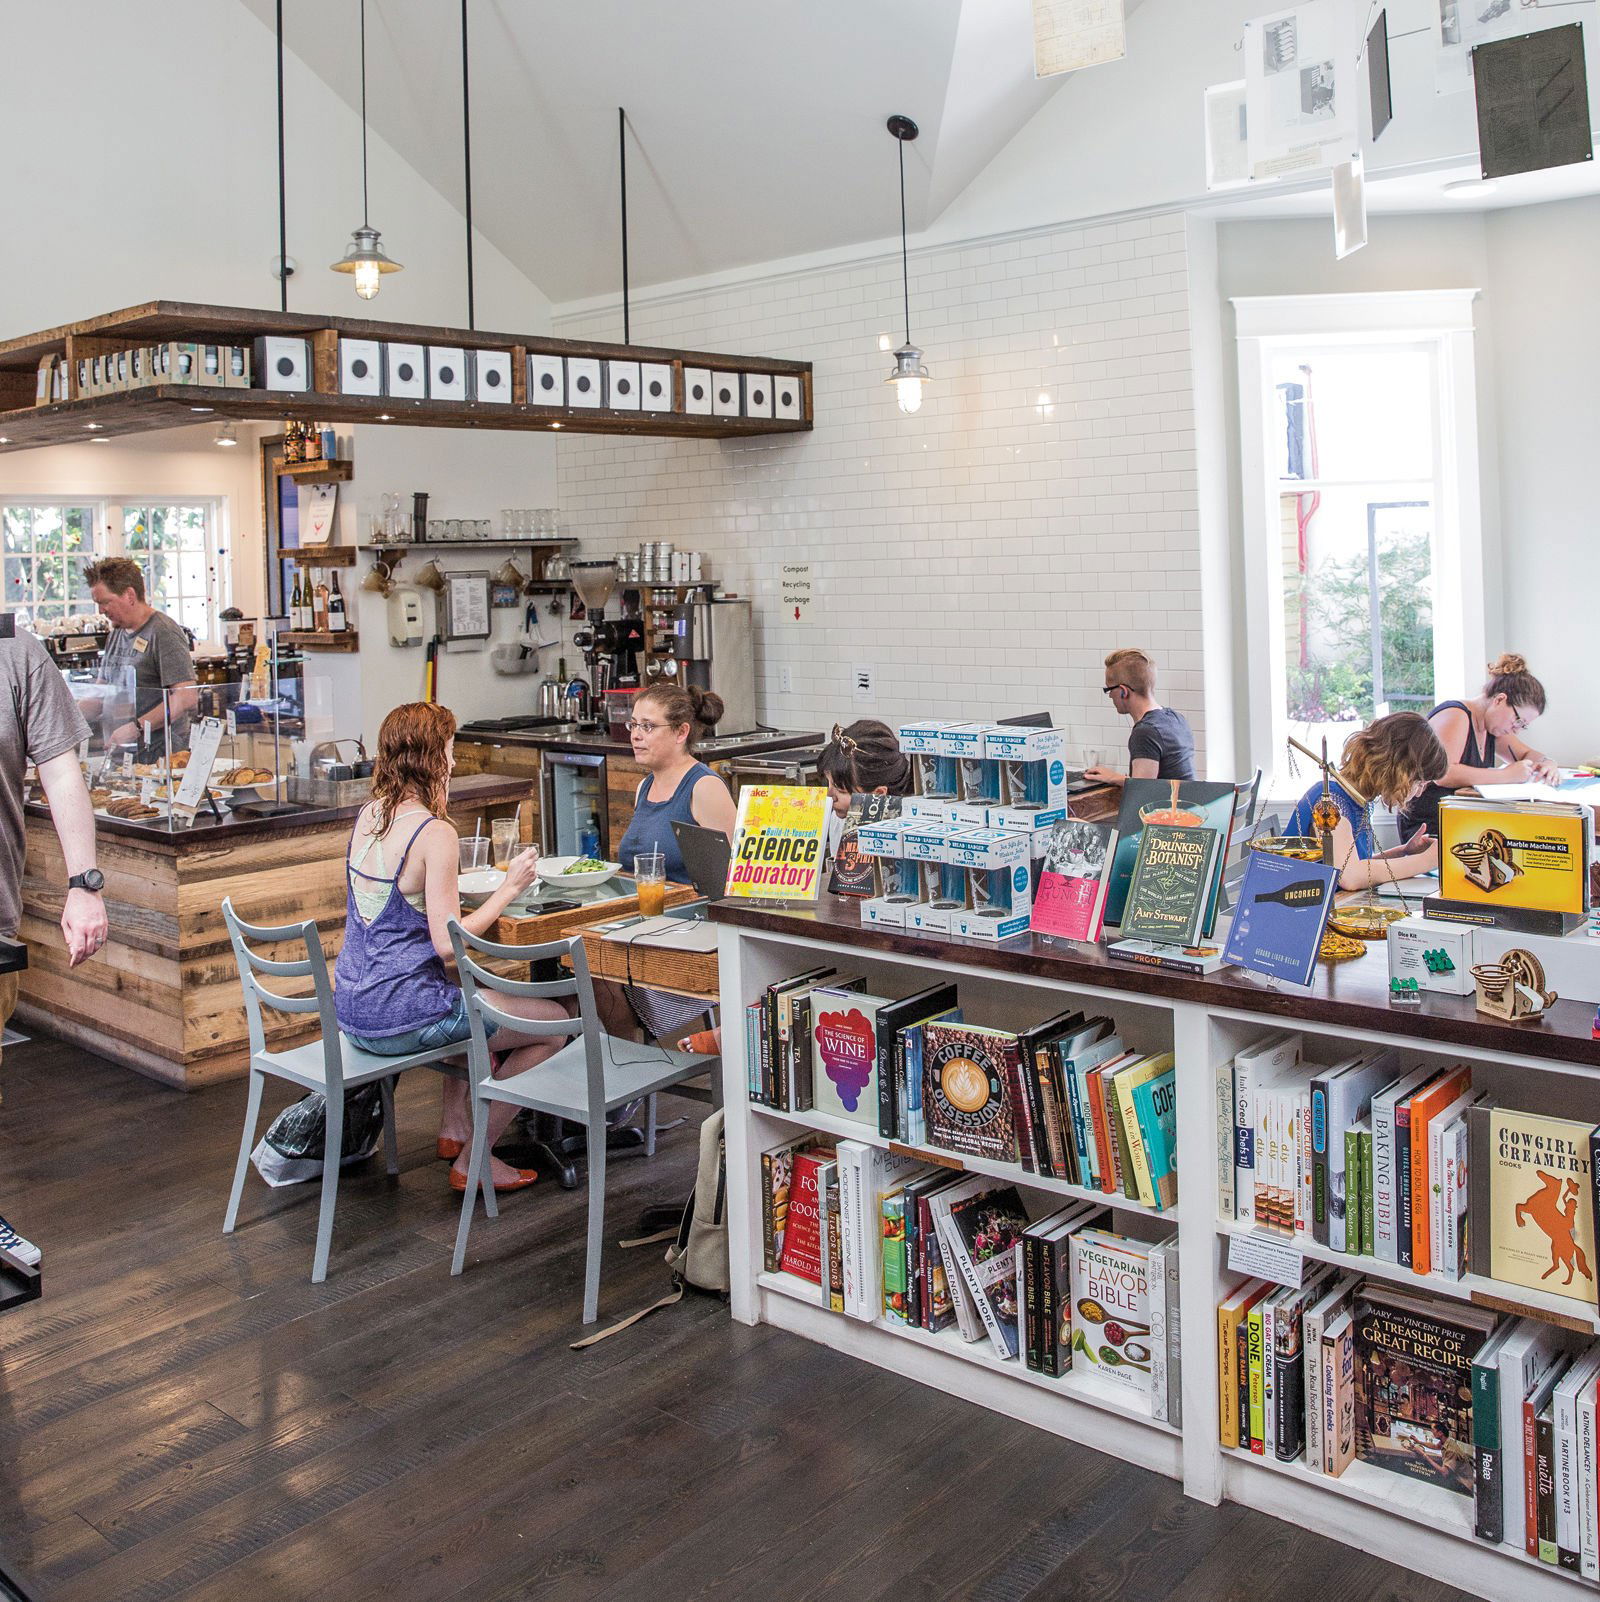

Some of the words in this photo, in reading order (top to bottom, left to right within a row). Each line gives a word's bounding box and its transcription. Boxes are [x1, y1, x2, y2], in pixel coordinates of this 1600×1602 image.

[782, 581, 811, 589] Recycling
[783, 596, 810, 605] Garbage
[732, 828, 818, 862] Science
[766, 828, 817, 838] Build-It-Yourself
[1172, 832, 1185, 841] THE
[1506, 840, 1528, 849] Marble
[1530, 842, 1556, 851] Machine
[1151, 839, 1204, 853] DRUNKEN
[1146, 850, 1204, 869] BOTANIST
[1285, 888, 1320, 900] UNCORKED
[1134, 907, 1154, 921] AMY
[1154, 909, 1187, 922] STEWART
[1134, 953, 1162, 965] PROOF
[824, 1029, 834, 1037] THE
[835, 1032, 856, 1042] SCIENCE
[824, 1037, 866, 1059] WINE
[938, 1044, 992, 1072] COFFEE
[1238, 1075, 1248, 1099] Italy's
[935, 1089, 1001, 1126] OBSESSION
[1106, 1099, 1114, 1108] 12
[1239, 1099, 1248, 1127] Great
[1083, 1102, 1092, 1132] MODERN
[1124, 1106, 1135, 1130] WINE
[961, 1136, 980, 1145] GLOBAL
[981, 1139, 1003, 1149] RECIPES
[1106, 1111, 1119, 1153] BOTTLE
[1129, 1131, 1136, 1139] in
[1219, 1126, 1231, 1150] Orange
[1239, 1129, 1249, 1154] Chefs
[1315, 1126, 1323, 1145] AMERICA
[1499, 1127, 1577, 1156] COWGIRL
[1130, 1139, 1142, 1170] WORDS
[1376, 1119, 1390, 1185] BAKING
[1499, 1143, 1590, 1174] CREAMERY
[1114, 1156, 1122, 1179] BAR
[1219, 1151, 1233, 1184] Blossoms
[1414, 1168, 1421, 1176] TO
[1499, 1161, 1522, 1169] COOKS
[764, 1176, 772, 1216] MASTERING
[842, 1167, 850, 1226] MODERNIST
[1348, 1192, 1357, 1203] In
[1364, 1192, 1373, 1203] In
[1415, 1193, 1422, 1202] AN
[1347, 1205, 1357, 1236] Season
[1362, 1205, 1373, 1237] Season
[1378, 1191, 1391, 1241] BIBLE
[784, 1255, 812, 1271] HAROLD
[941, 1242, 961, 1307] OTTOLENGHI
[988, 1255, 1014, 1273] PLENTY
[1082, 1248, 1145, 1276] VEGETARIAN
[1078, 1259, 1148, 1296] FLAVOR
[960, 1256, 980, 1295] PLENTY
[979, 1299, 995, 1328] MORE
[1088, 1281, 1138, 1312] BIBLE
[1368, 1308, 1392, 1320] MARY
[1403, 1317, 1440, 1334] VINCENT
[1441, 1328, 1466, 1341] PRICE
[1372, 1319, 1380, 1328] A
[1382, 1320, 1441, 1346] TREASURY
[1444, 1339, 1462, 1352] OF
[1249, 1322, 1260, 1364] DONE.
[1362, 1327, 1410, 1352] GREAT
[1414, 1342, 1473, 1371] RECIPES
[1098, 1363, 1116, 1376] KAREN
[1117, 1369, 1132, 1381] PAGE
[1309, 1374, 1317, 1391] Real
[1325, 1365, 1334, 1395] Cooking
[1252, 1373, 1260, 1403] Peterson
[1310, 1393, 1318, 1410] Food
[1311, 1412, 1319, 1449] Cookbook
[1525, 1424, 1533, 1435] JUICE
[1582, 1411, 1590, 1436] EATING
[1483, 1453, 1492, 1480] Relæ
[1561, 1438, 1570, 1472] TARTINE
[1583, 1437, 1591, 1473] DELANCEY
[1538, 1454, 1552, 1496] miette
[1562, 1473, 1570, 1496] BOOK
